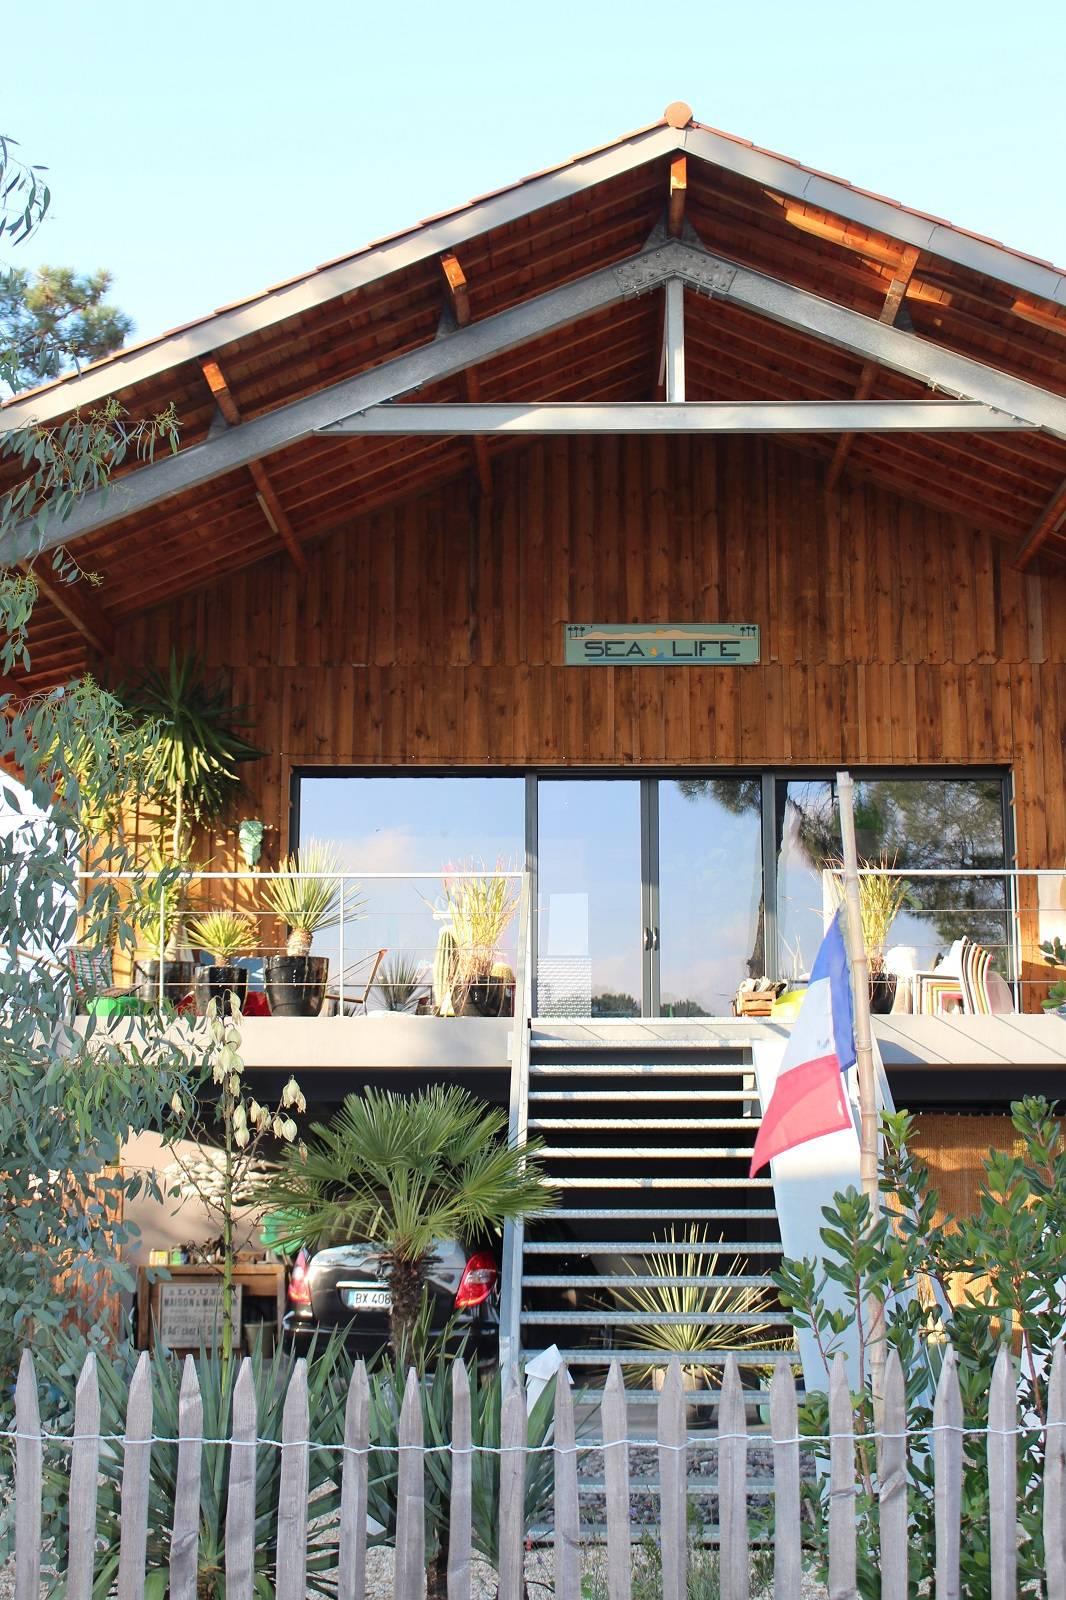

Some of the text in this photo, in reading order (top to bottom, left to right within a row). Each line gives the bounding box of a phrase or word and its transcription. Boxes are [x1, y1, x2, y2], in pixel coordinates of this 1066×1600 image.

[584, 641, 741, 657] SEA LIFE
[356, 1293, 391, 1305] BX 408
